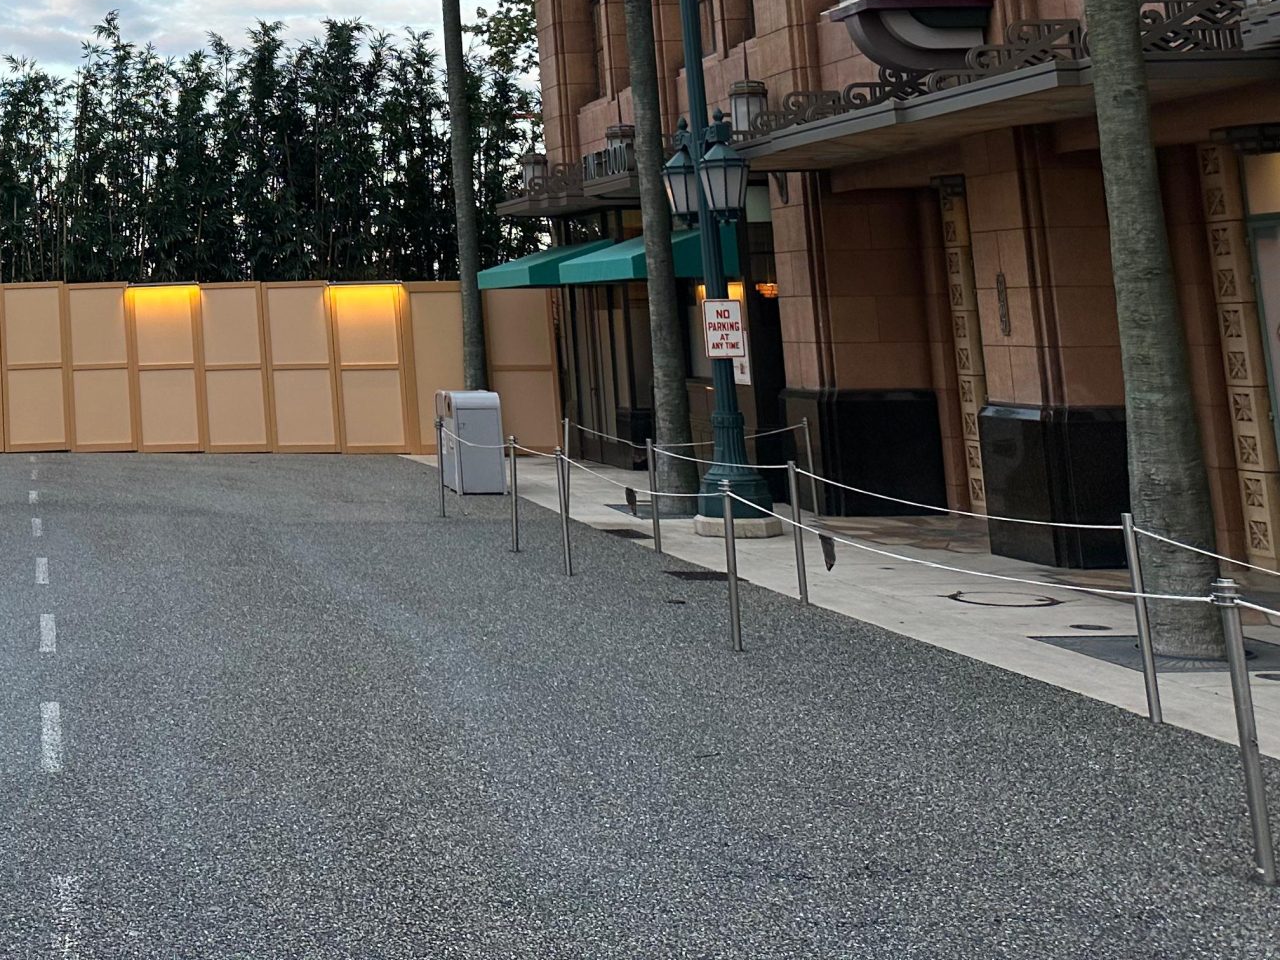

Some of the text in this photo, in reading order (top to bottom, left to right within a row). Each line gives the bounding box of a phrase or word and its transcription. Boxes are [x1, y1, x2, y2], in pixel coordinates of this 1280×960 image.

[716, 309, 730, 319] NO
[708, 322, 740, 332] PARKING
[720, 333, 729, 341] AT
[711, 341, 740, 349] ANY TIME
